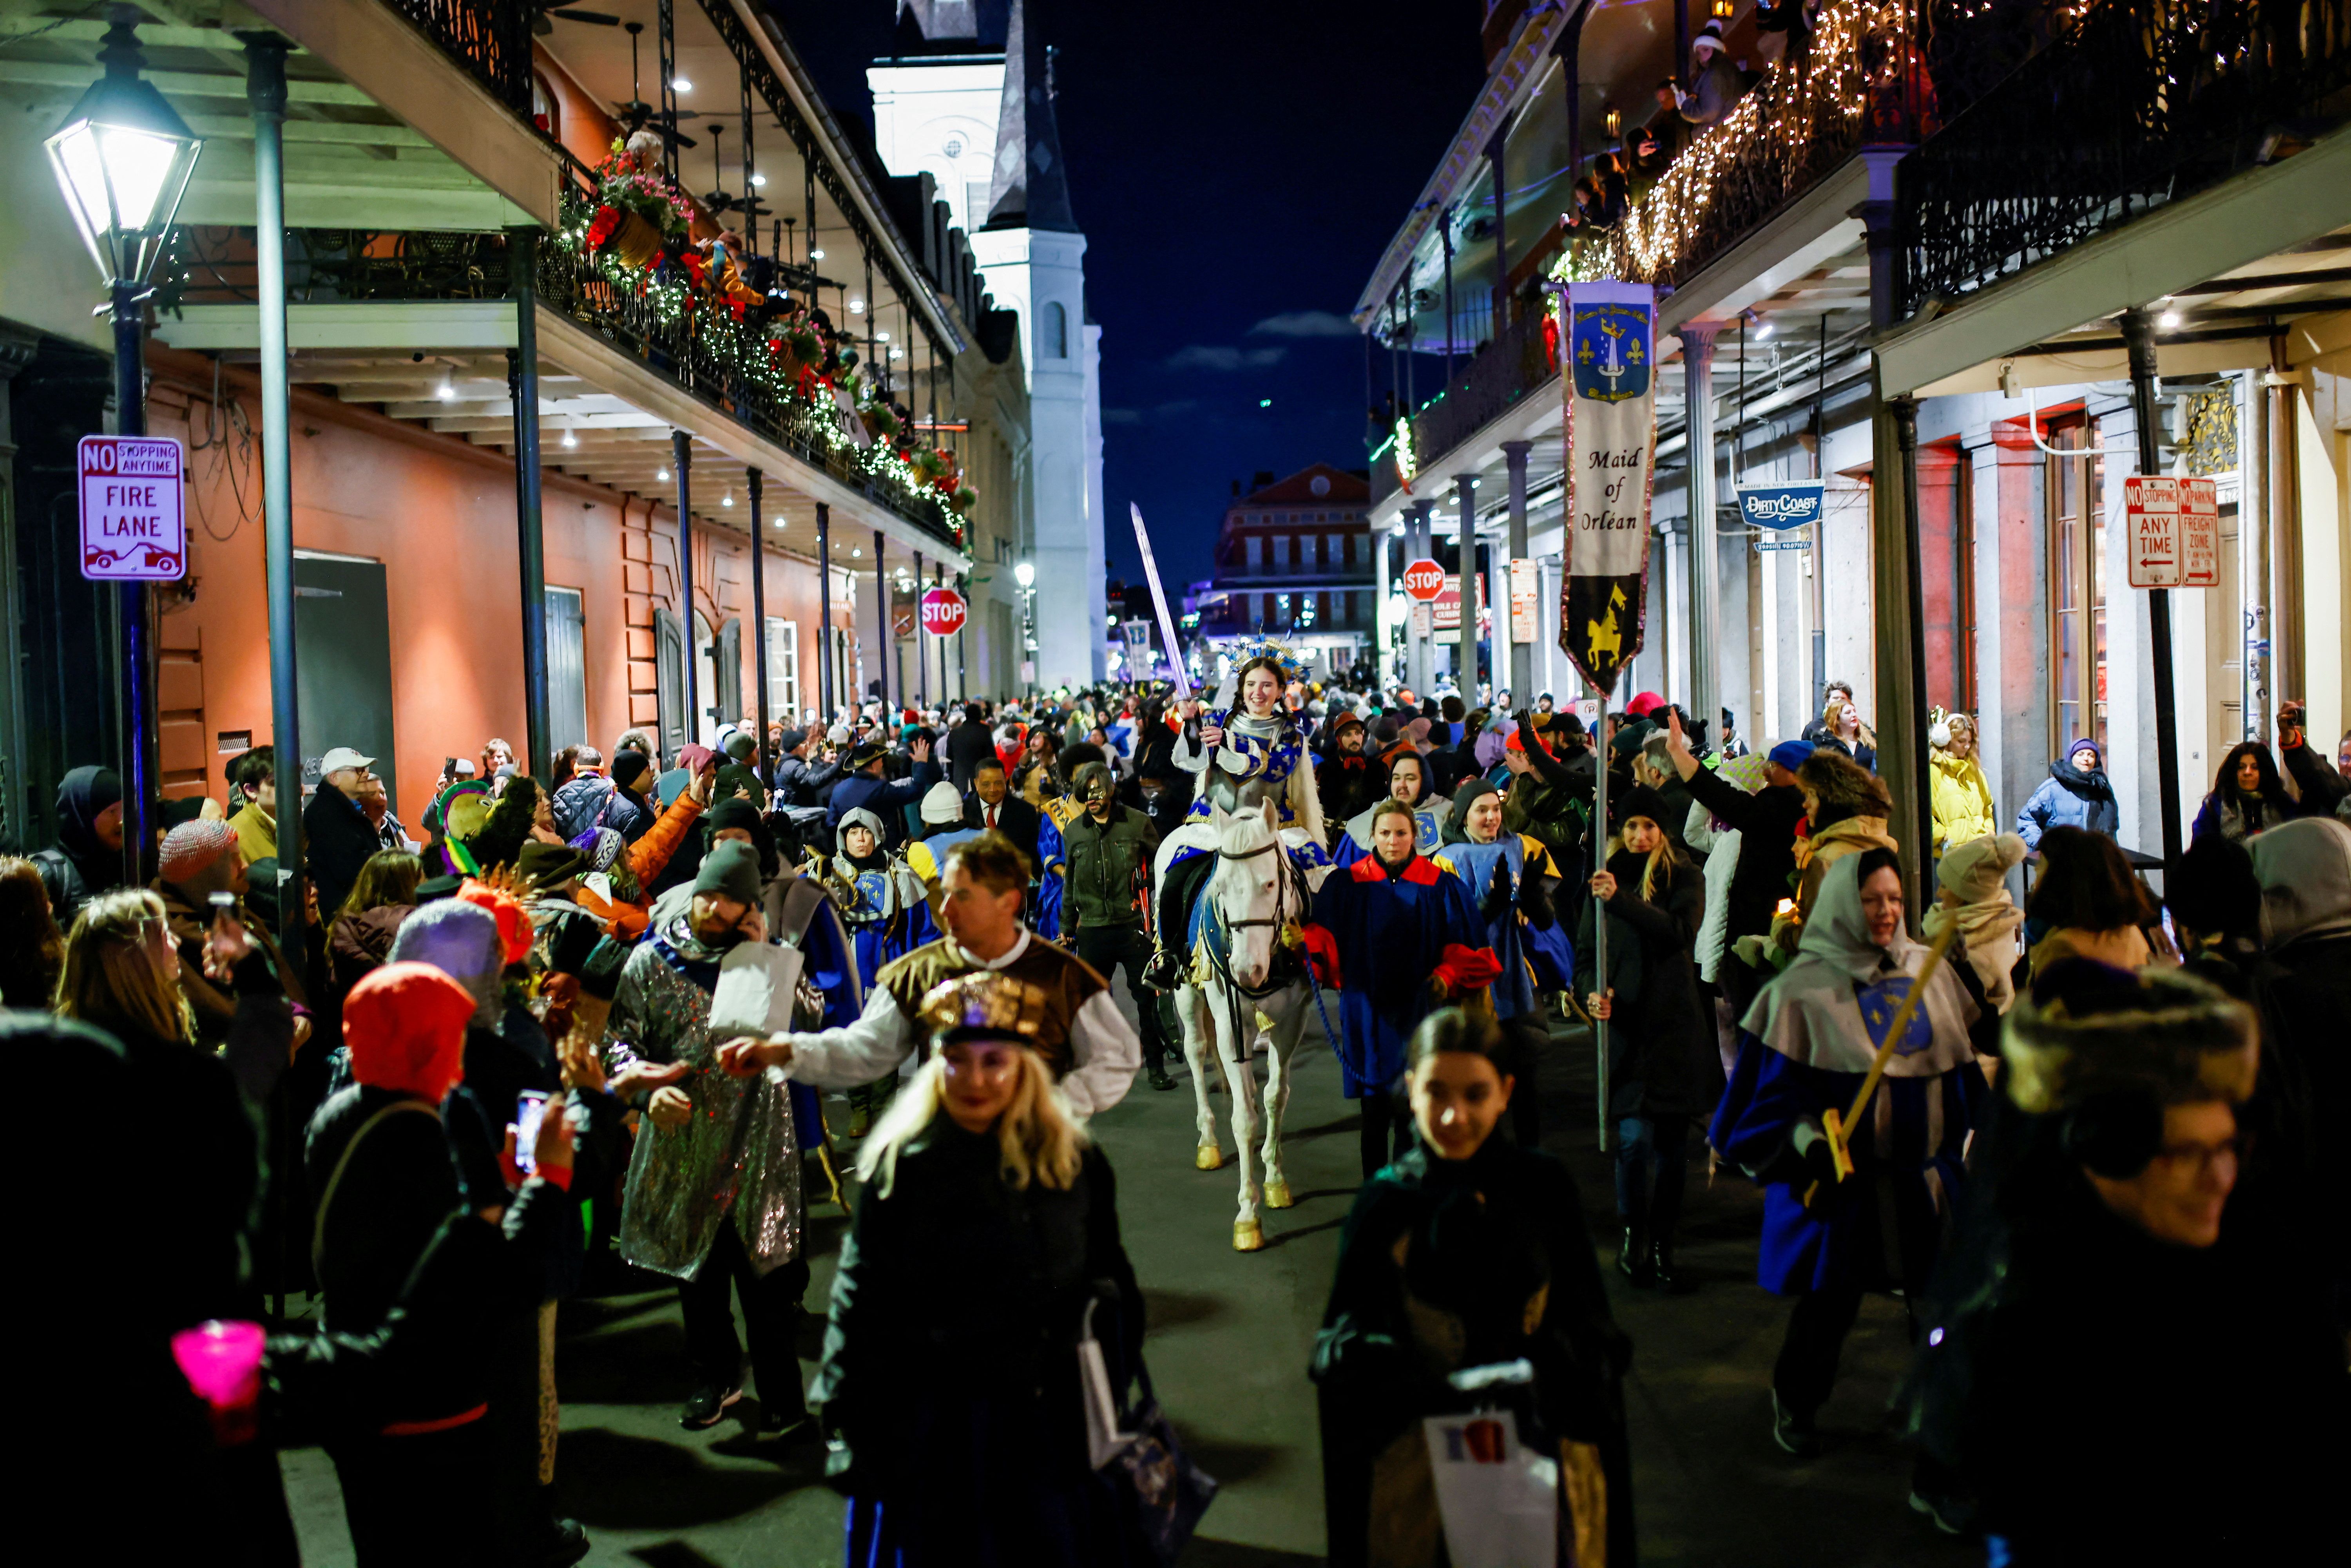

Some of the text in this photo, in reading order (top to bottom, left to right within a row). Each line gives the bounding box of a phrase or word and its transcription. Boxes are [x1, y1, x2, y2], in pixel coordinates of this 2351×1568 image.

[84, 444, 116, 471] NO
[118, 445, 176, 458] STOPPING
[1589, 447, 1643, 469] Maid
[123, 460, 172, 472] ANYTIME
[107, 485, 157, 507] FIRE
[1605, 476, 1626, 503] of
[2126, 485, 2142, 506] NO
[2144, 489, 2176, 503] STOPPING
[2180, 487, 2191, 506] NO
[103, 515, 161, 537] LANE
[1582, 510, 1636, 530] Orléan
[2140, 517, 2170, 534] ANY
[2184, 517, 2213, 531] FREIGHT
[2139, 537, 2172, 554] TIME
[2190, 534, 2209, 549] ZONE
[1406, 572, 1442, 589] STOP
[922, 603, 963, 622] STOP
